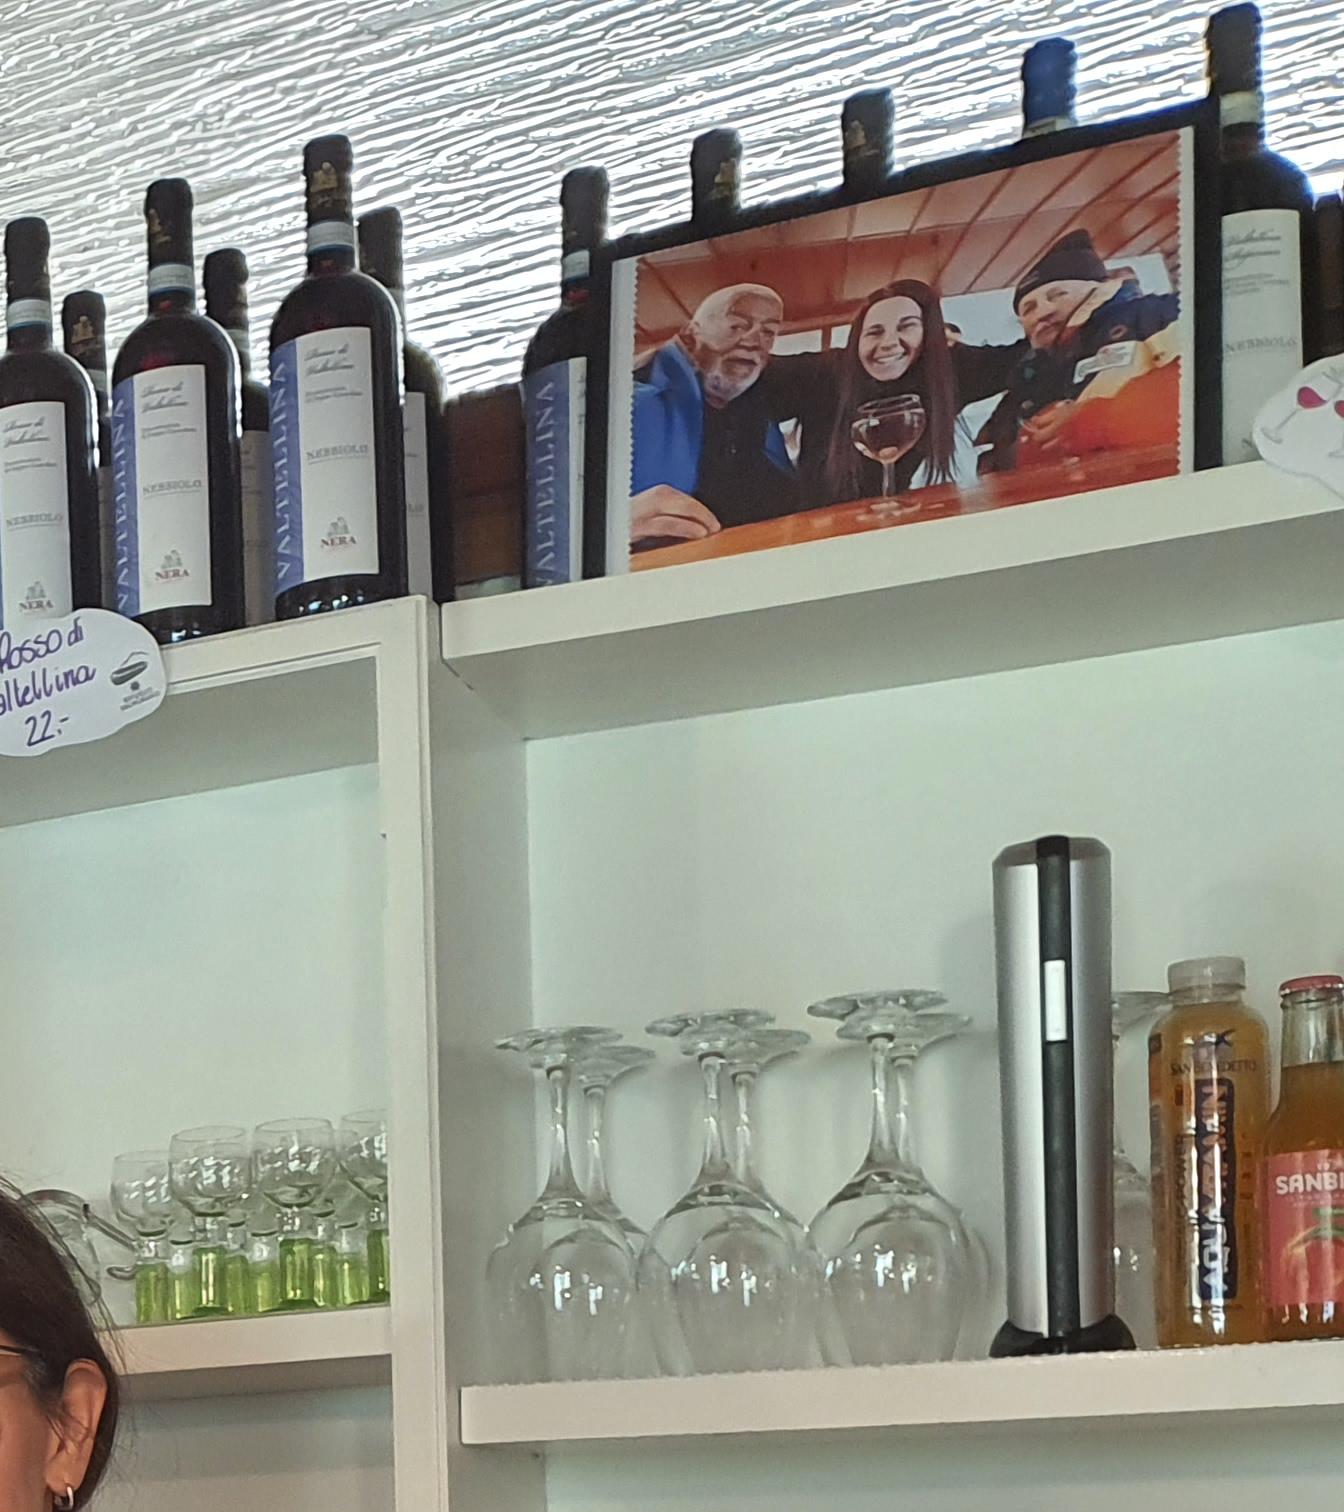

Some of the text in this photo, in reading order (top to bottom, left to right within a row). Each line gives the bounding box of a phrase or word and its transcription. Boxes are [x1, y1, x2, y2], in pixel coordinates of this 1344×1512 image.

[272, 362, 290, 579] VALTELLINA
[113, 399, 129, 610] VALTELLINA
[320, 535, 357, 549] NERA
[154, 567, 190, 581] NERA
[18, 599, 54, 611] NERA
[66, 616, 84, 647] di
